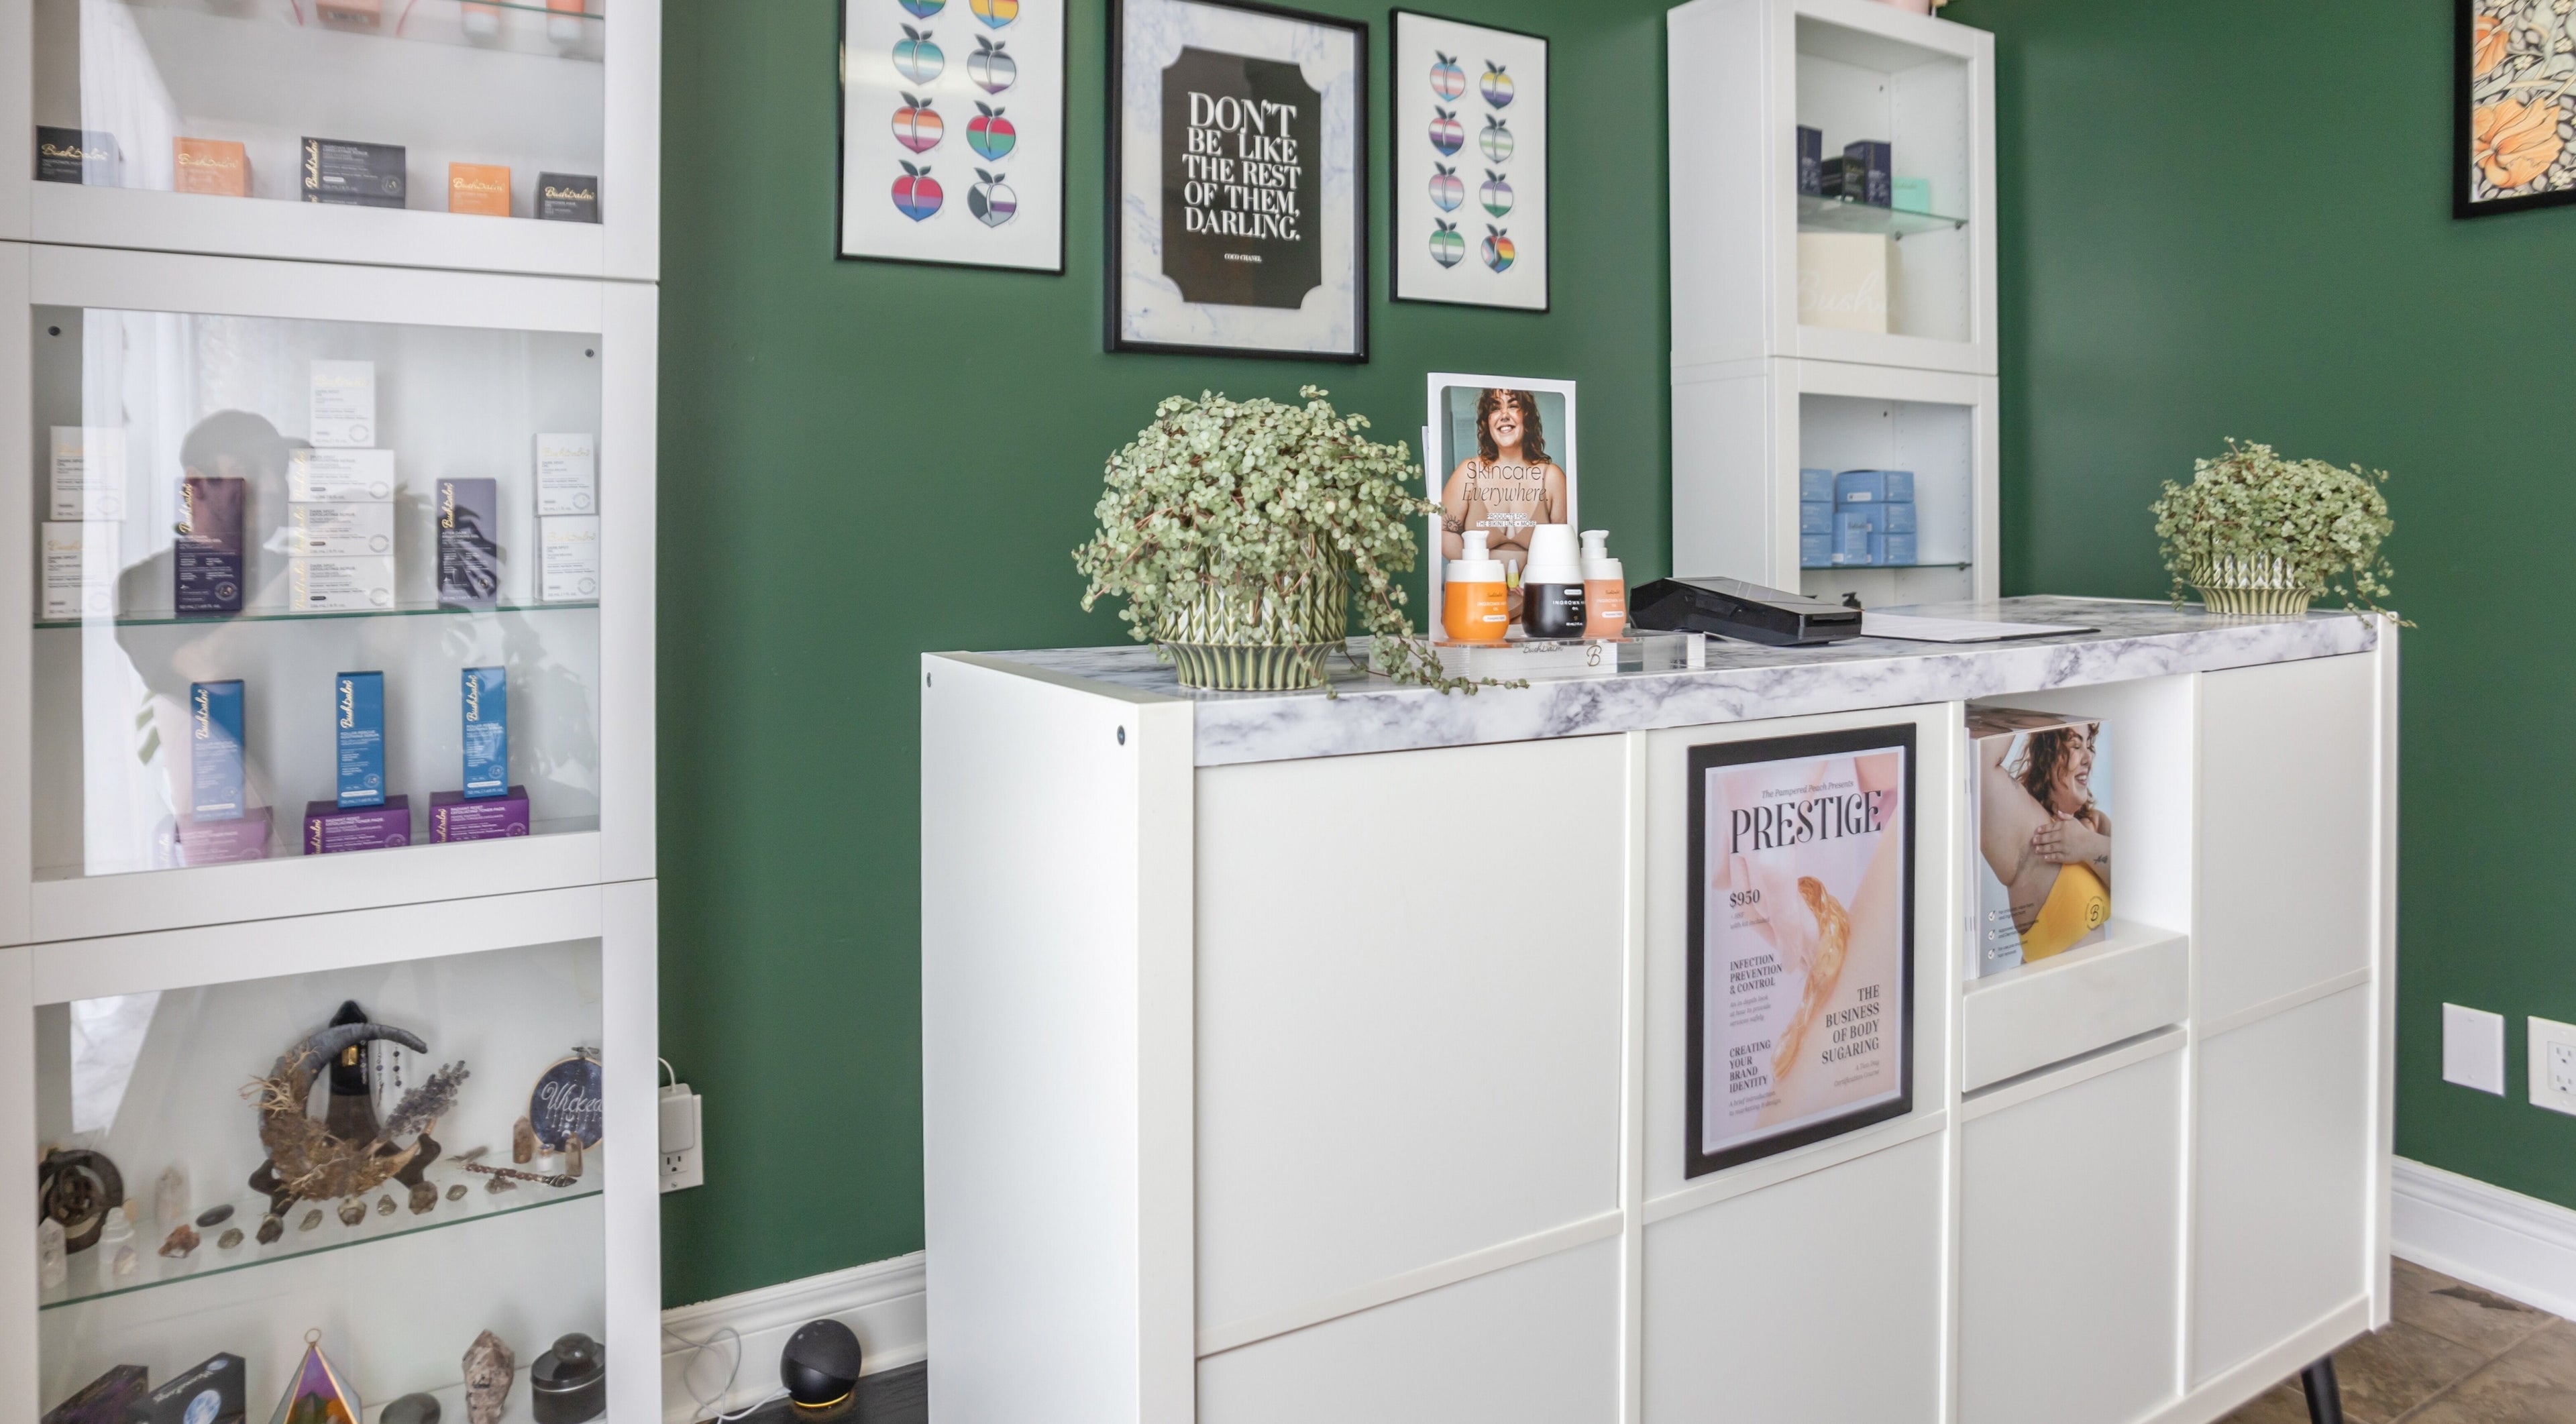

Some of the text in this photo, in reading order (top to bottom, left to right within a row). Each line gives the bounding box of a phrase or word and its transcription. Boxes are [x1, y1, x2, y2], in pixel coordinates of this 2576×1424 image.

[1188, 91, 1297, 138] DON'T
[1187, 126, 1299, 165] BE LIKE
[1182, 153, 1302, 190] THE REST
[1184, 180, 1301, 217] OF THEM,
[1184, 206, 1301, 241] DARLING.
[1224, 253, 1263, 262] COCO CHANEL
[1466, 461, 1545, 481] Skincare.
[1462, 482, 1549, 506] Everywhere.
[1586, 645, 1602, 667] B
[1762, 780, 1854, 799] The Pampered Peach Presents
[435, 808, 447, 842] ushbalm
[1730, 790, 1881, 854] PRESTIGE
[310, 819, 322, 855] ushbalm
[1729, 889, 1761, 909] $950
[1730, 953, 1774, 971] INFECTION
[1730, 963, 1782, 983] PREVENTION
[1729, 977, 1776, 995] & CONTROL
[1858, 984, 1880, 1001] THE
[1826, 1001, 1880, 1028] BUSINESS
[1833, 1019, 1880, 1044] OF BODY
[1729, 1040, 1771, 1058] CREATING
[1821, 1037, 1880, 1064] SUGARING
[1729, 1056, 1753, 1069] YOUR
[1729, 1066, 1758, 1081] BRAND
[1729, 1075, 1768, 1093] IDENTITY
